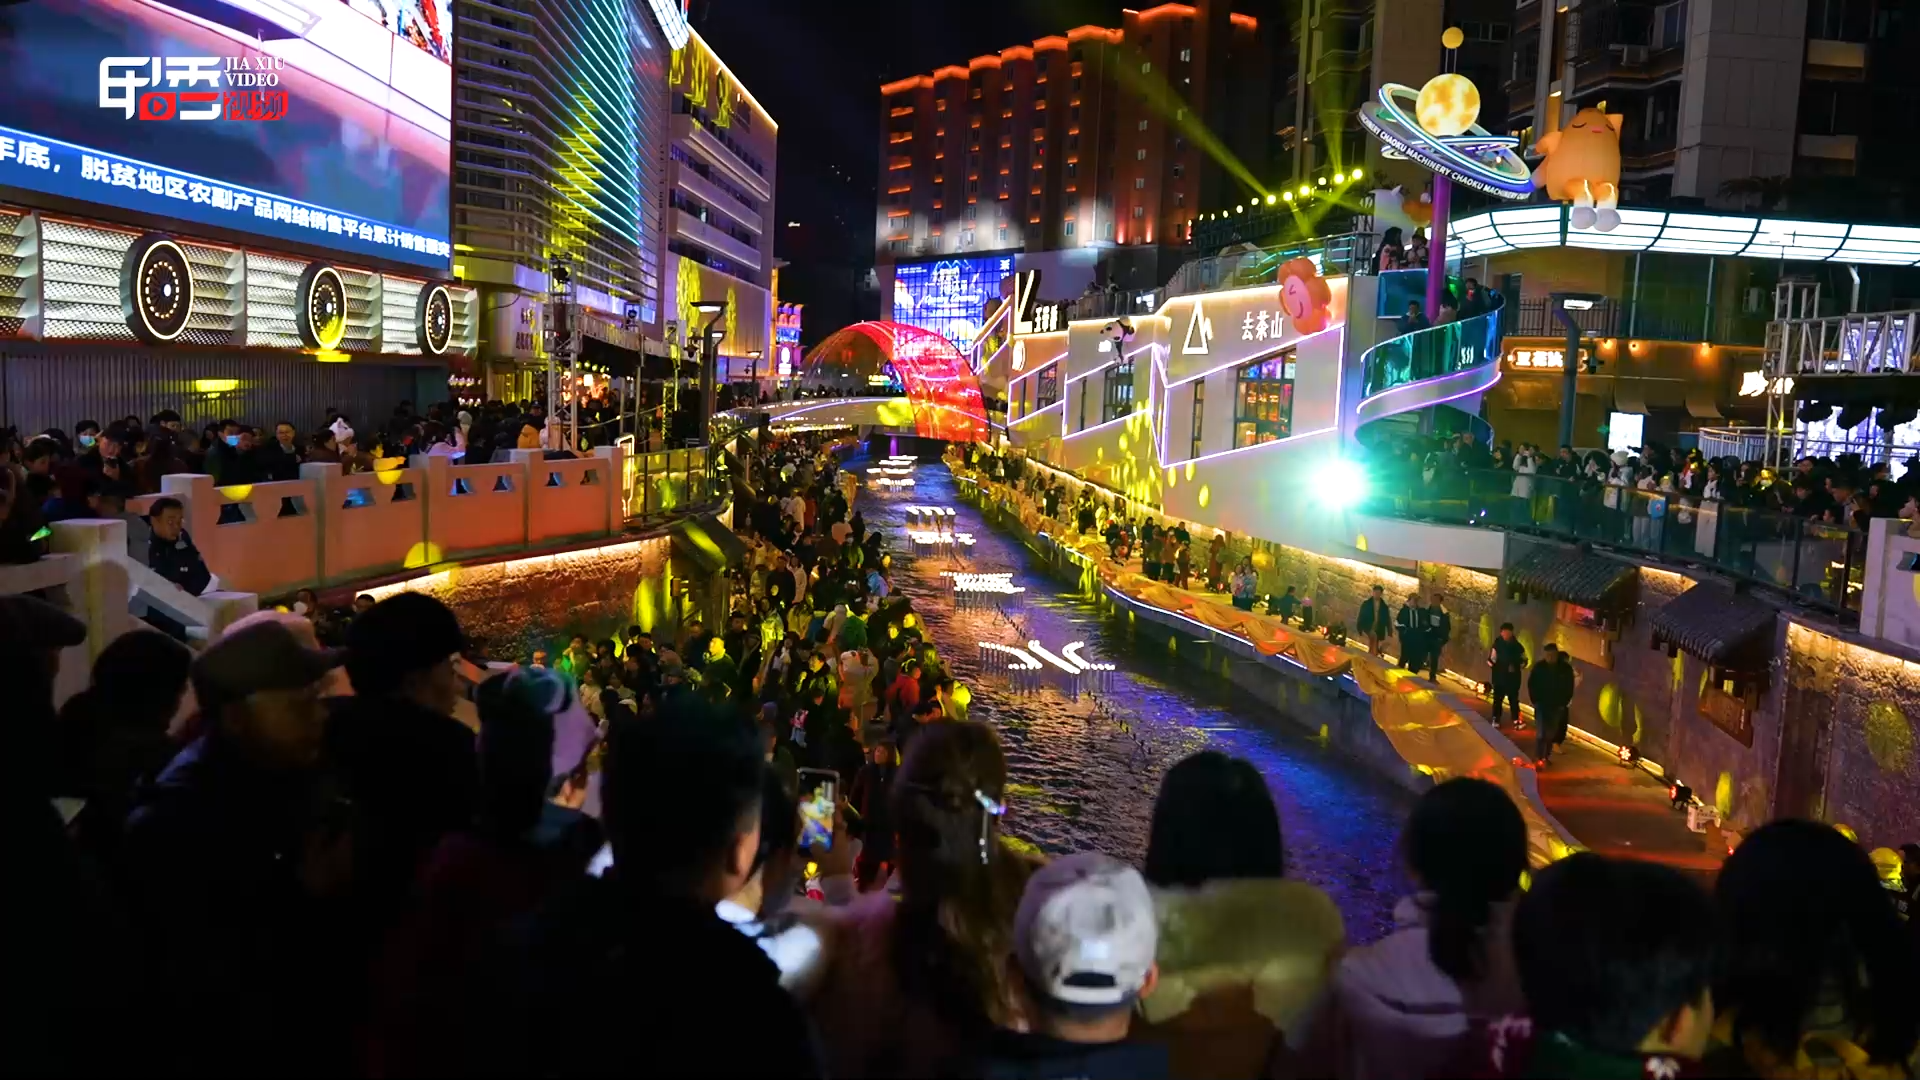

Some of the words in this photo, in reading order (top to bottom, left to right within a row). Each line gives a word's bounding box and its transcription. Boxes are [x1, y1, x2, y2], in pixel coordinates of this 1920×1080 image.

[1405, 147, 1452, 176] MACHINERY
[1451, 171, 1485, 190] CHAOKU
[1241, 309, 1284, 341] 去茶山
